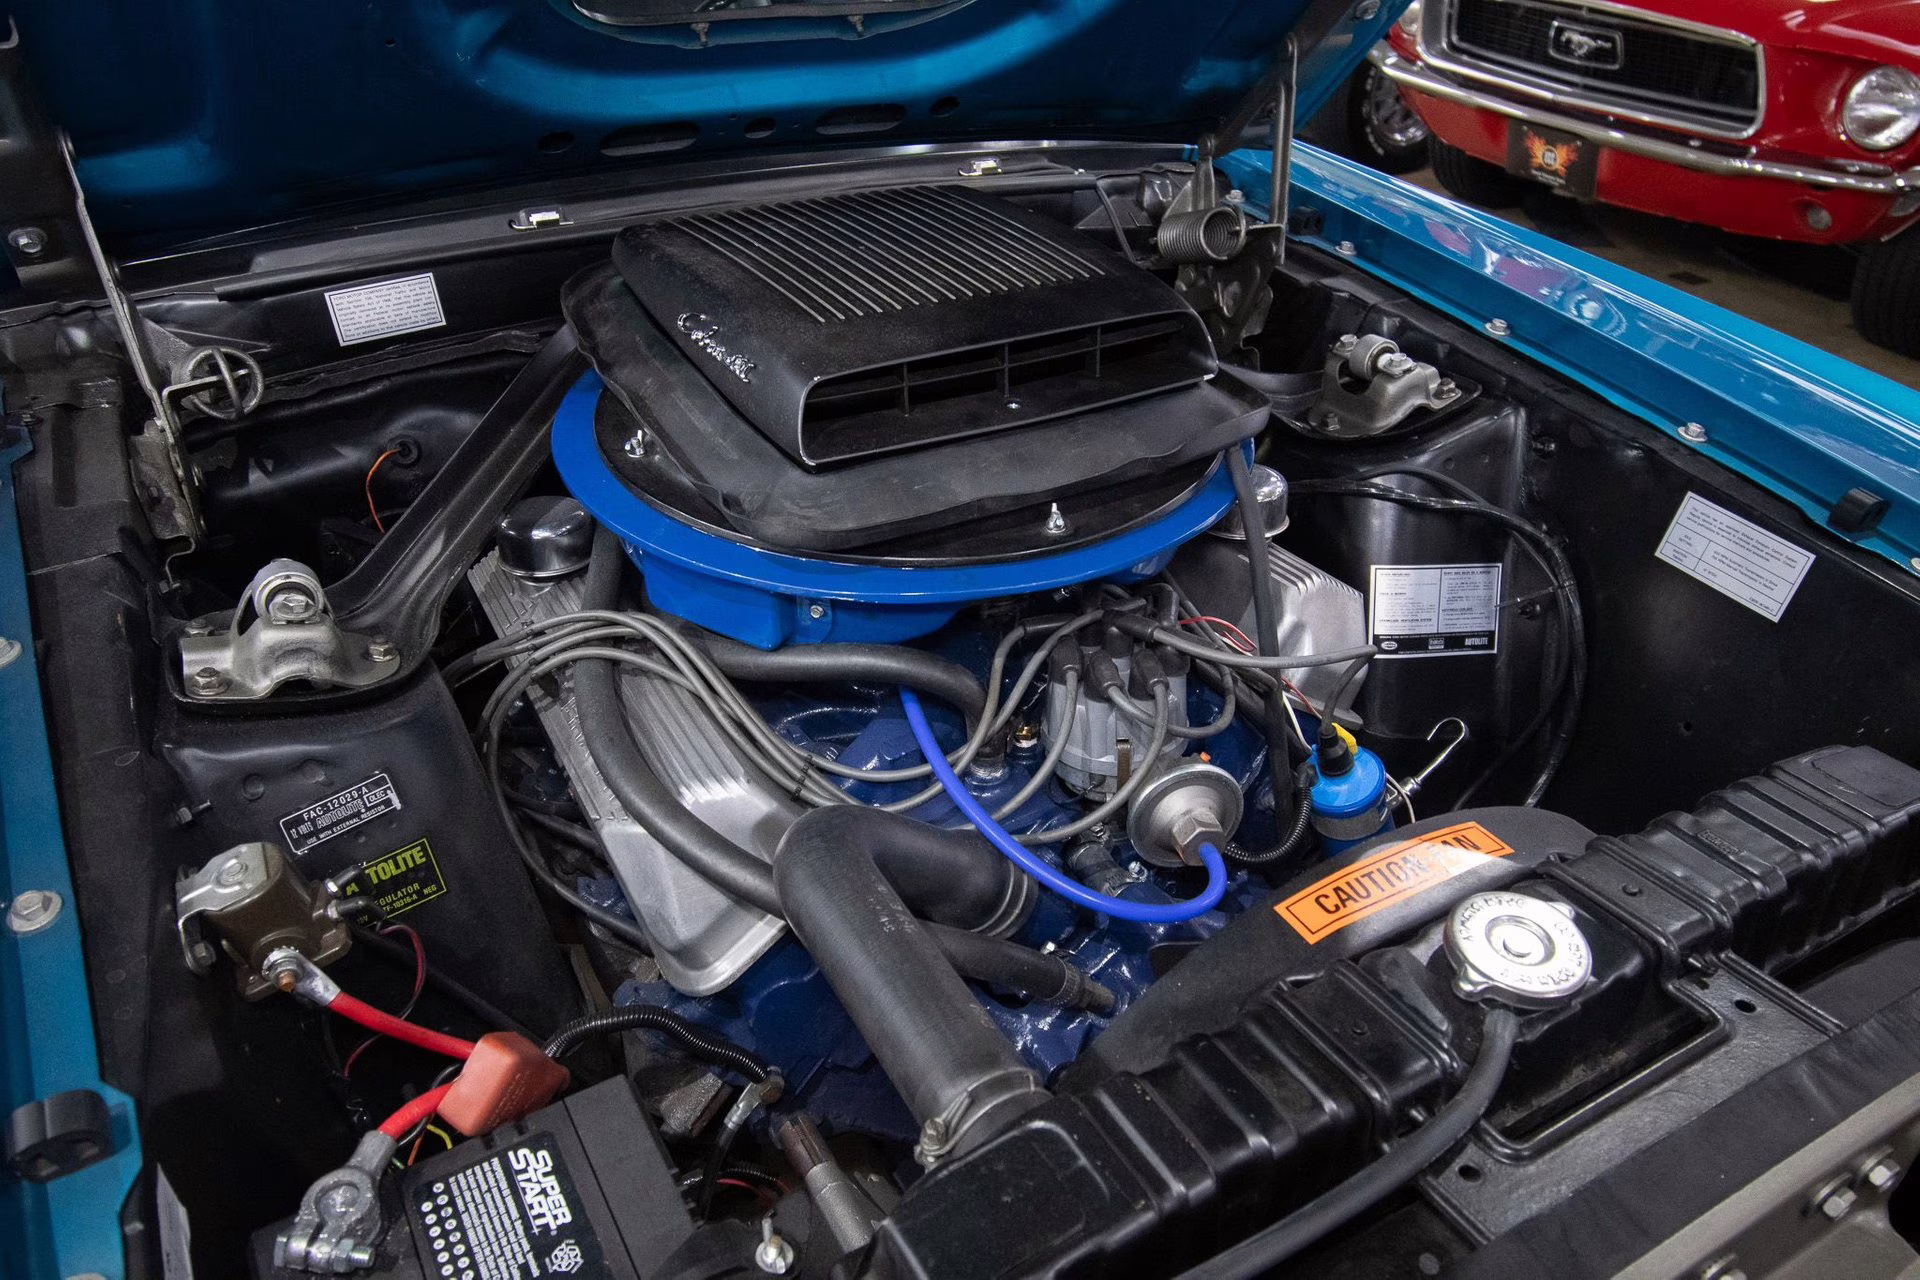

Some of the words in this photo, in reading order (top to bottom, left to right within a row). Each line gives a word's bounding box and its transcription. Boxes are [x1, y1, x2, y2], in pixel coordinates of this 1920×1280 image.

[302, 786, 369, 821] FAC-12029-A
[316, 798, 365, 829] AUTOLITE
[332, 817, 361, 833] EXTERNAL
[361, 804, 387, 820] RESISTOR
[345, 846, 427, 895] ATOLITE
[1314, 853, 1429, 916] CAUTION
[375, 882, 421, 907] GULATOR
[423, 884, 437, 895] NEG
[508, 1148, 557, 1230] START
[530, 1149, 573, 1226] SUPER
